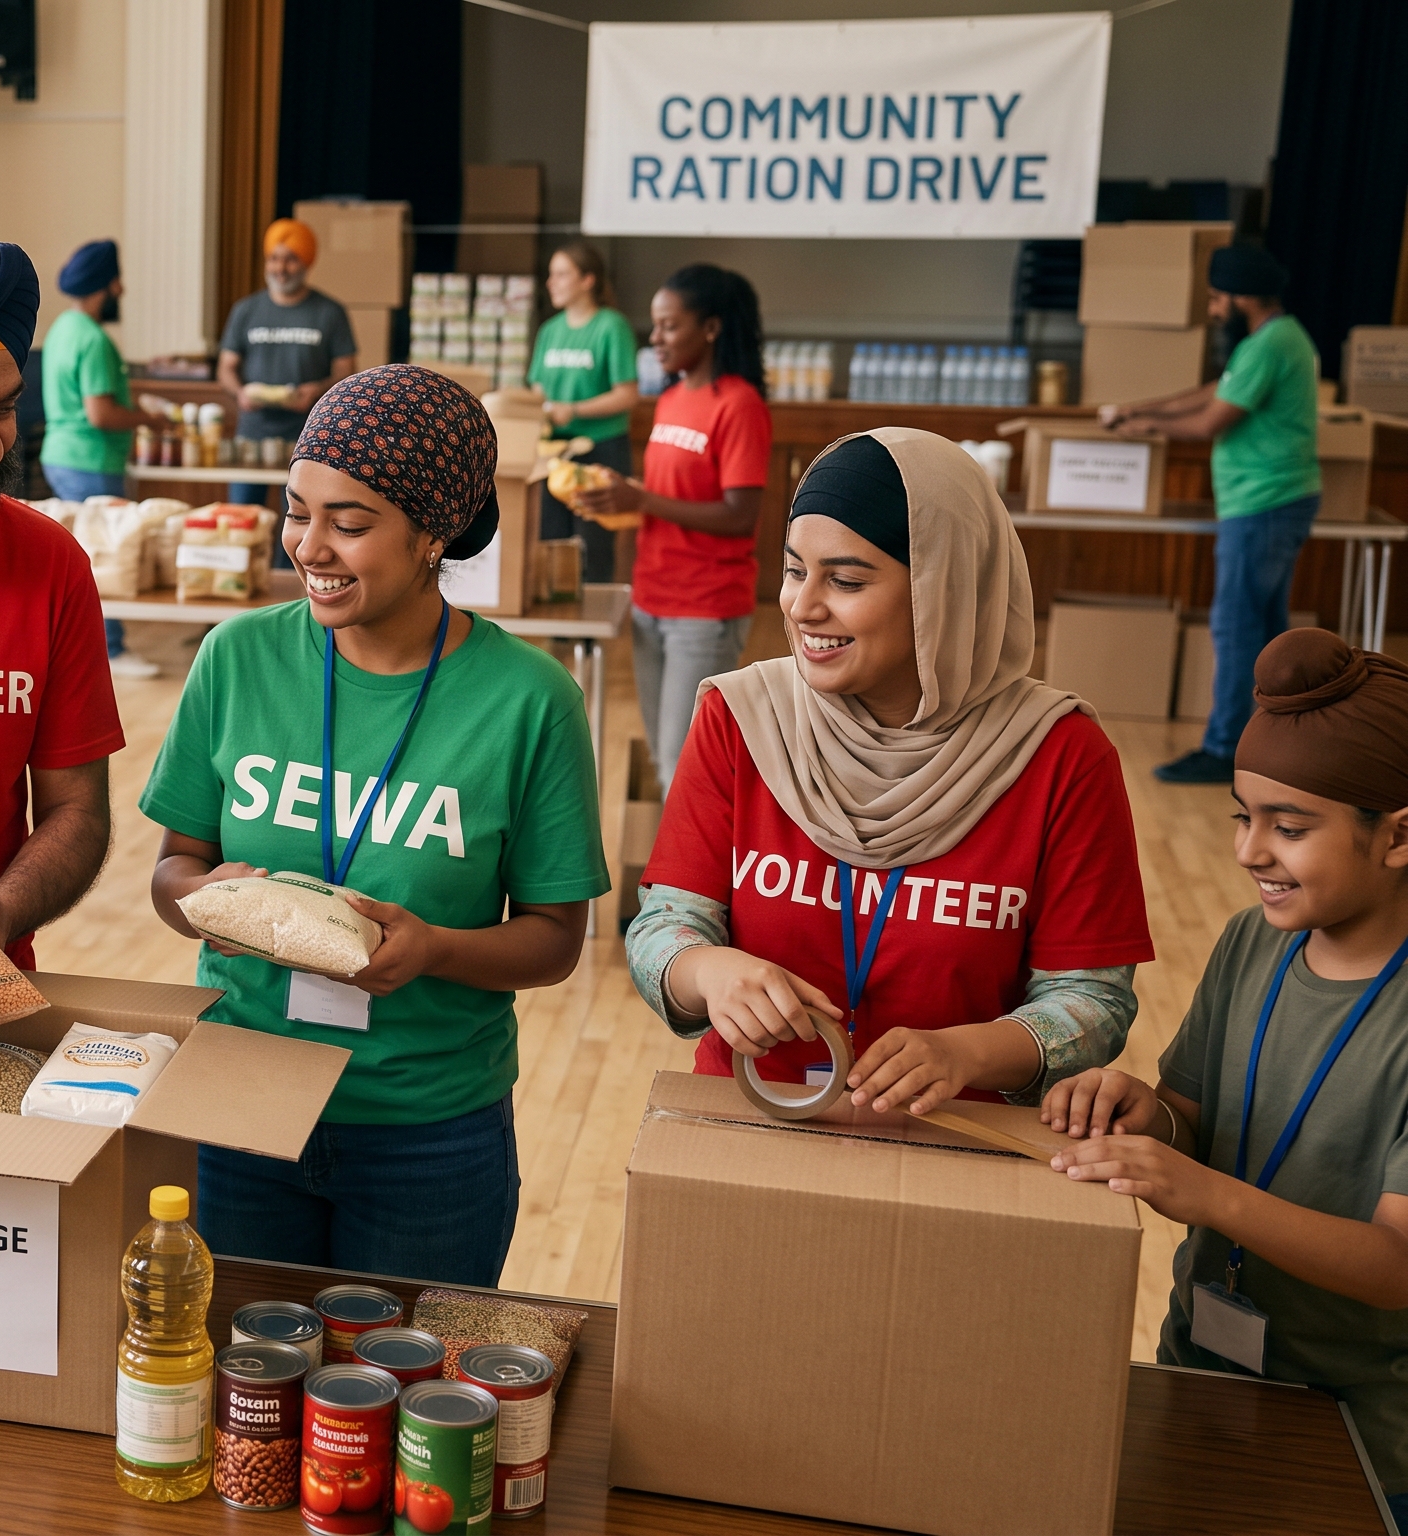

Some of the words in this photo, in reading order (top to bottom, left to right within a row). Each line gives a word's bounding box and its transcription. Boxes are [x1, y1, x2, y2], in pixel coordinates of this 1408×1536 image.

[659, 92, 1022, 141] COMMUNITY
[630, 156, 844, 201] RATION
[867, 155, 1048, 201] DRIVE
[230, 754, 465, 858] SEWA
[732, 846, 1027, 930] VOLUNTEER
